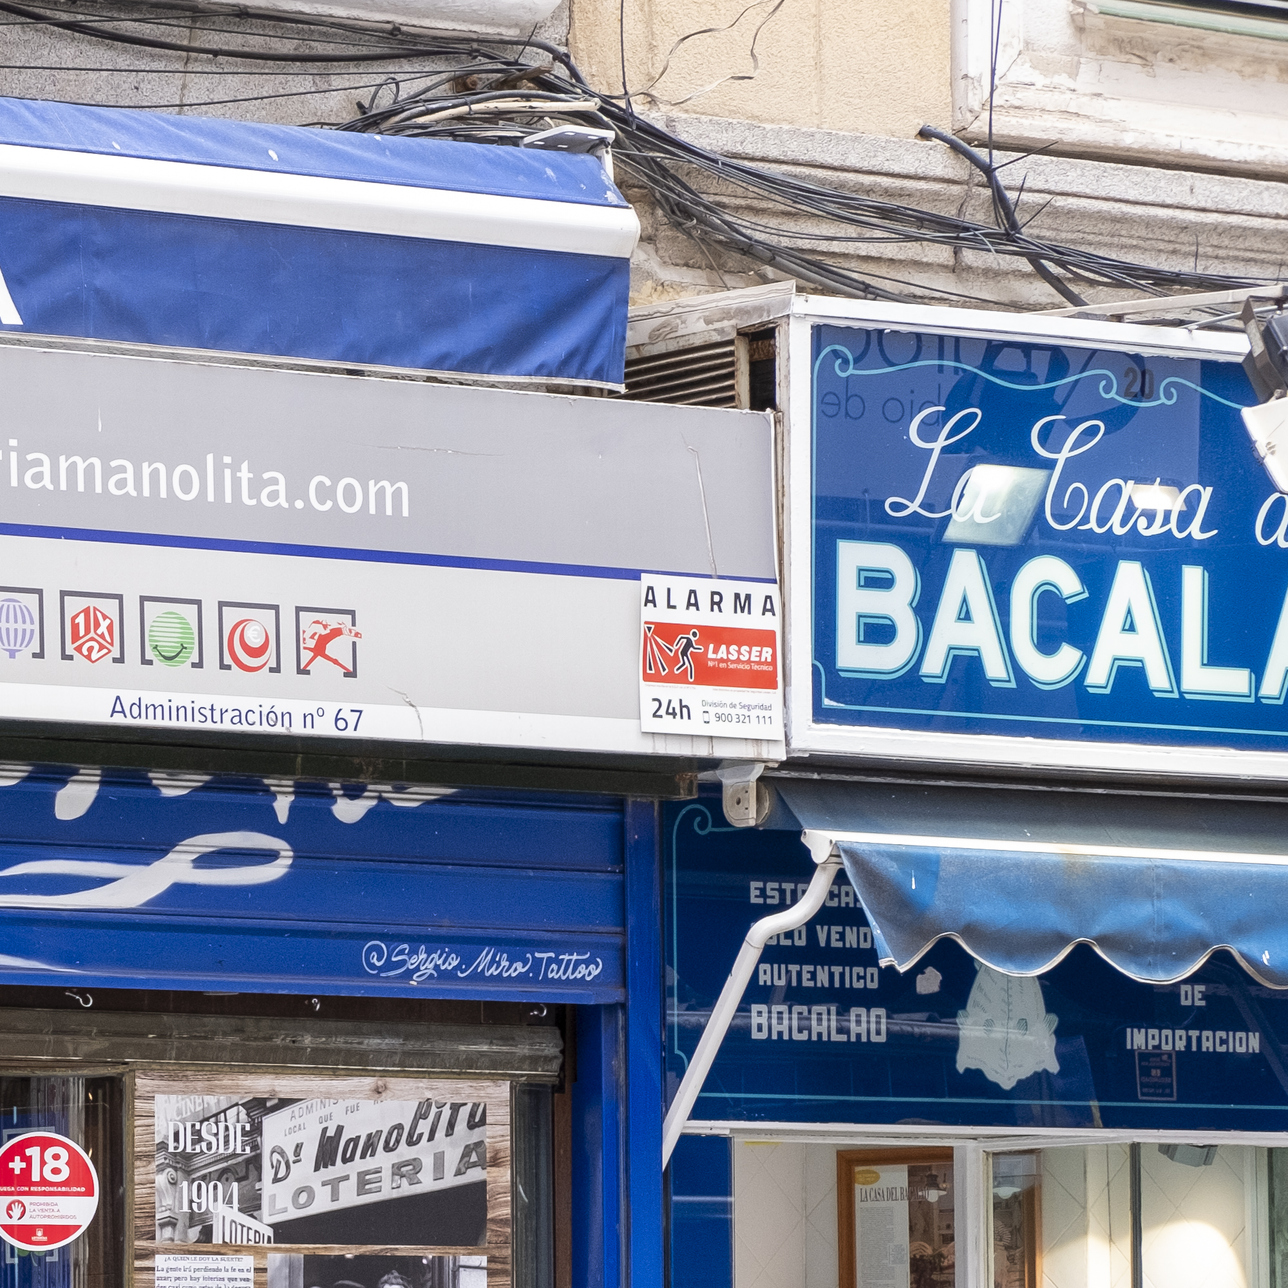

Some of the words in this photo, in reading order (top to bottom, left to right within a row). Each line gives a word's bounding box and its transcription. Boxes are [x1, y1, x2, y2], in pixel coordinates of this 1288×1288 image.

[885, 406, 1001, 524] La
[1030, 415, 1218, 540] Casa
[643, 585, 777, 617] ALARMA
[707, 643, 773, 662] LASSER
[727, 661, 751, 670] Servicio
[750, 662, 773, 671] Técnico
[109, 695, 293, 730] Administración
[302, 706, 325, 730] nº
[333, 709, 363, 732] 67
[651, 697, 691, 720] 24h
[701, 699, 727, 709] División
[729, 701, 737, 709] de
[738, 701, 772, 712] Seguridad
[714, 712, 733, 723] 900
[735, 713, 751, 724] 321
[755, 714, 773, 725] 111
[816, 924, 876, 949] VEND
[758, 963, 879, 989] AUTENTICO
[1180, 984, 1206, 1006] DE
[751, 1003, 887, 1043] BACALAO
[1126, 1027, 1260, 1053] IMPORTACION
[168, 1121, 251, 1154] DESDE
[8, 1146, 70, 1183] +18
[268, 1140, 487, 1217] LOTERIA
[179, 1180, 240, 1213] 1904
